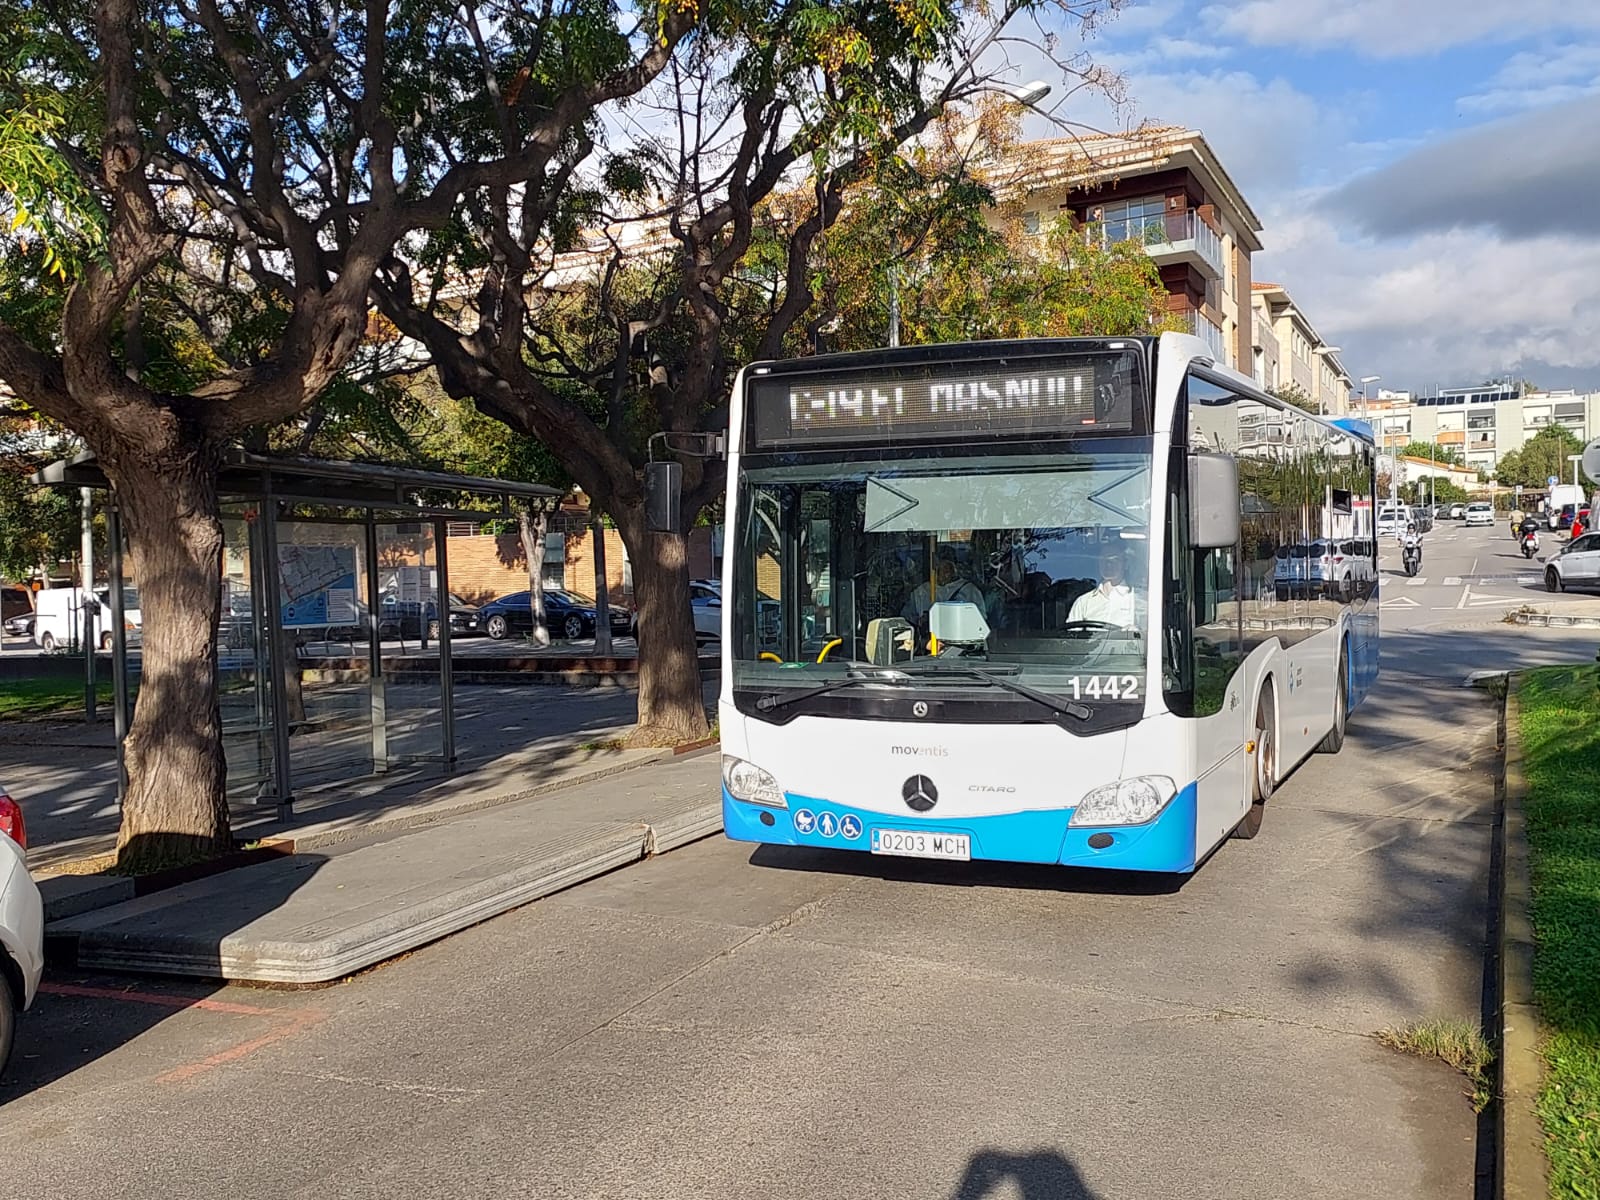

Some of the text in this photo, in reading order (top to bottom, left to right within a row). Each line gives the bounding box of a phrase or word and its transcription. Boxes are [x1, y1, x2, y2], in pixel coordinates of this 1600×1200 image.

[1068, 675, 1139, 700] 1442
[891, 744, 950, 757] moventis
[967, 784, 1017, 794] CITARO
[882, 833, 926, 853] 0203
[932, 837, 967, 856] MCH
